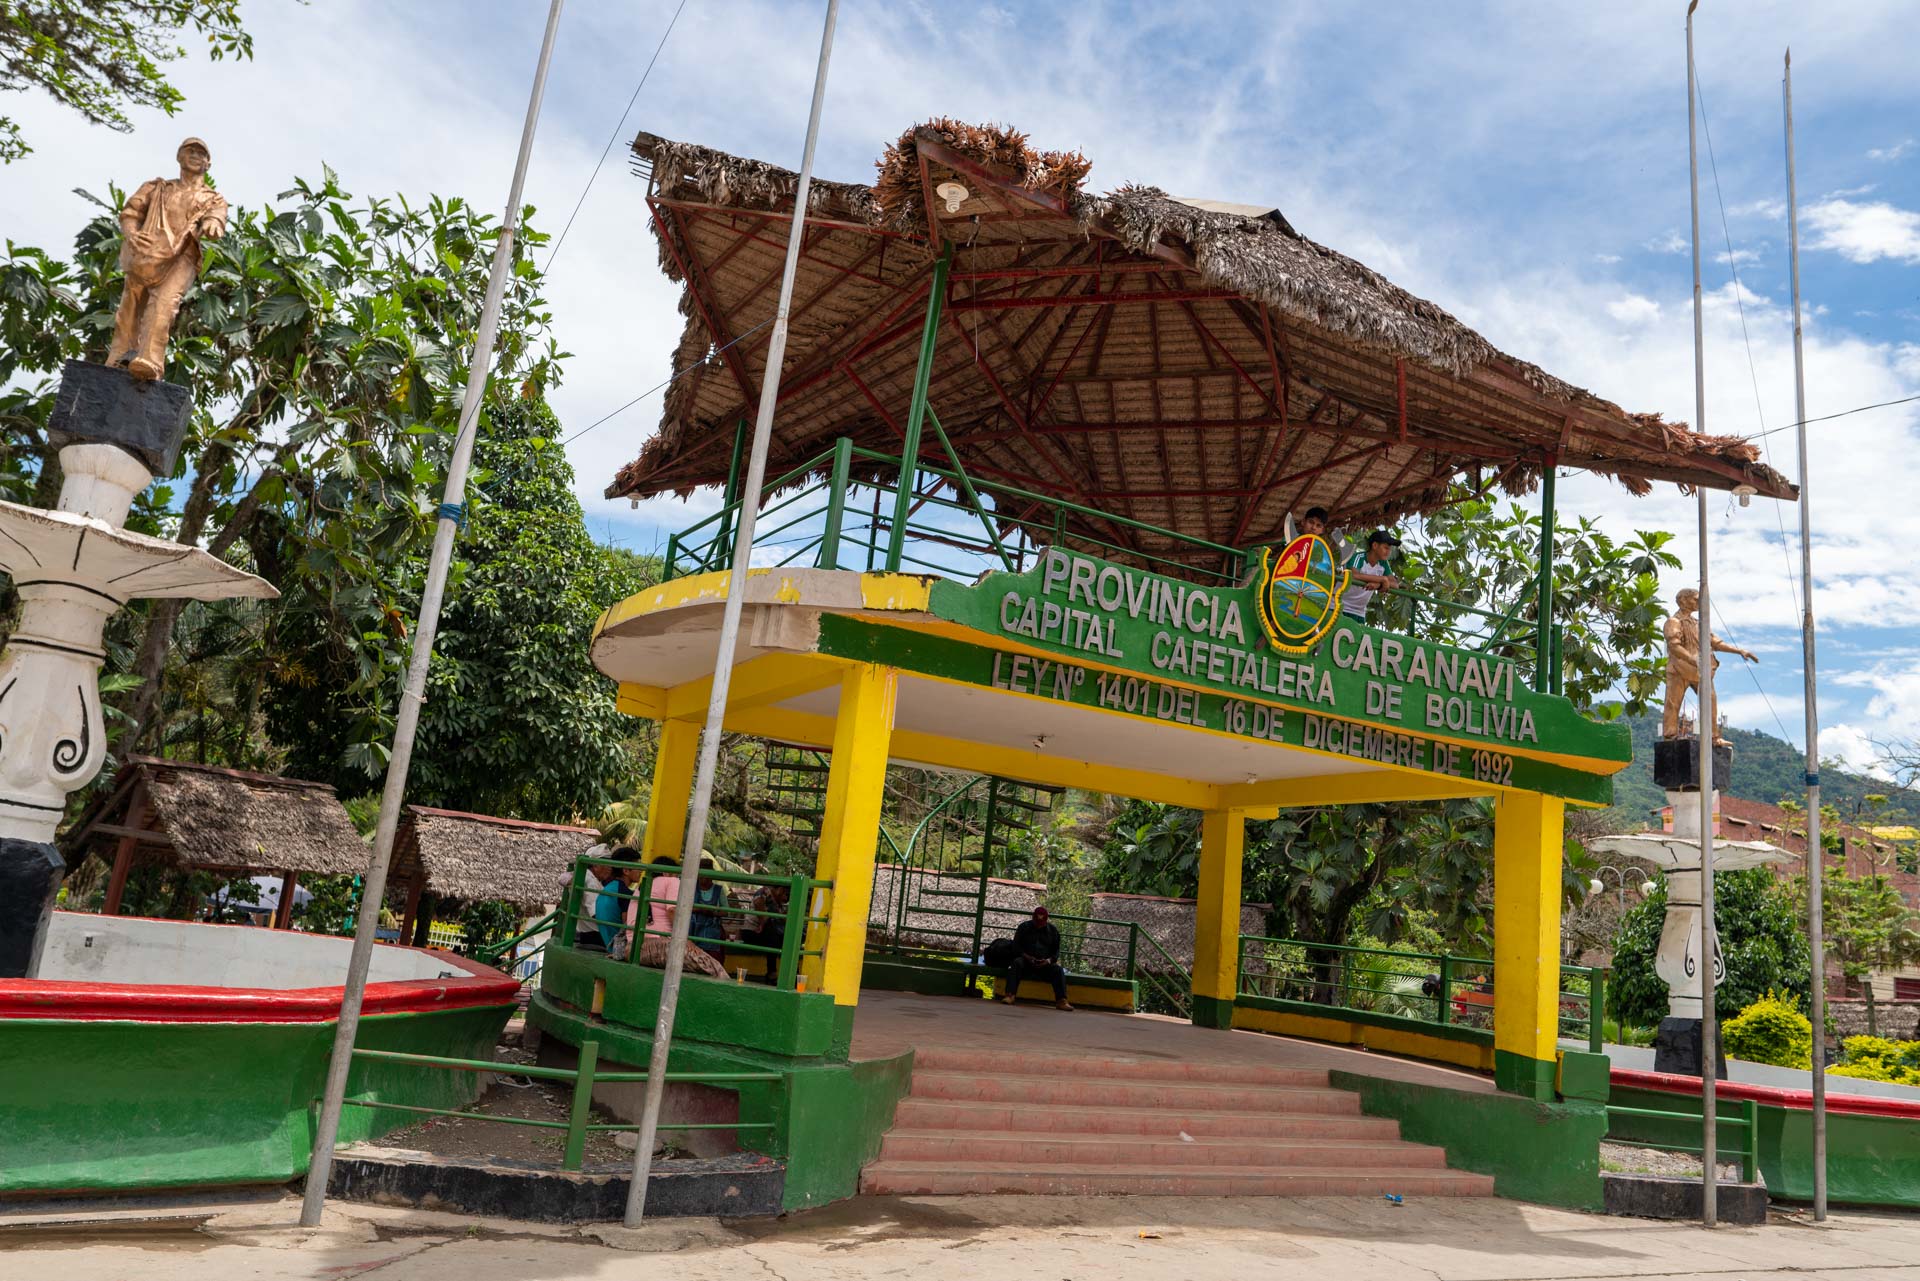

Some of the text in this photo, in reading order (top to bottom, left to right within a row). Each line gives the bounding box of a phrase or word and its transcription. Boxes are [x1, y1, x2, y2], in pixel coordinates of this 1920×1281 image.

[999, 591, 1539, 743] CAPITAL CAFETALERA DE BOLIVIA
[1042, 550, 1246, 645] PROVINCIA
[1333, 627, 1514, 702] CARANAVI
[991, 651, 1049, 696] LEY
[1096, 671, 1151, 716] 1401
[1156, 683, 1207, 728] DEL
[1223, 700, 1248, 735] 16
[1252, 703, 1286, 743] DE
[1303, 714, 1426, 771] DICIEMBRE
[1433, 742, 1462, 778] DE
[1471, 749, 1514, 788] 1992
